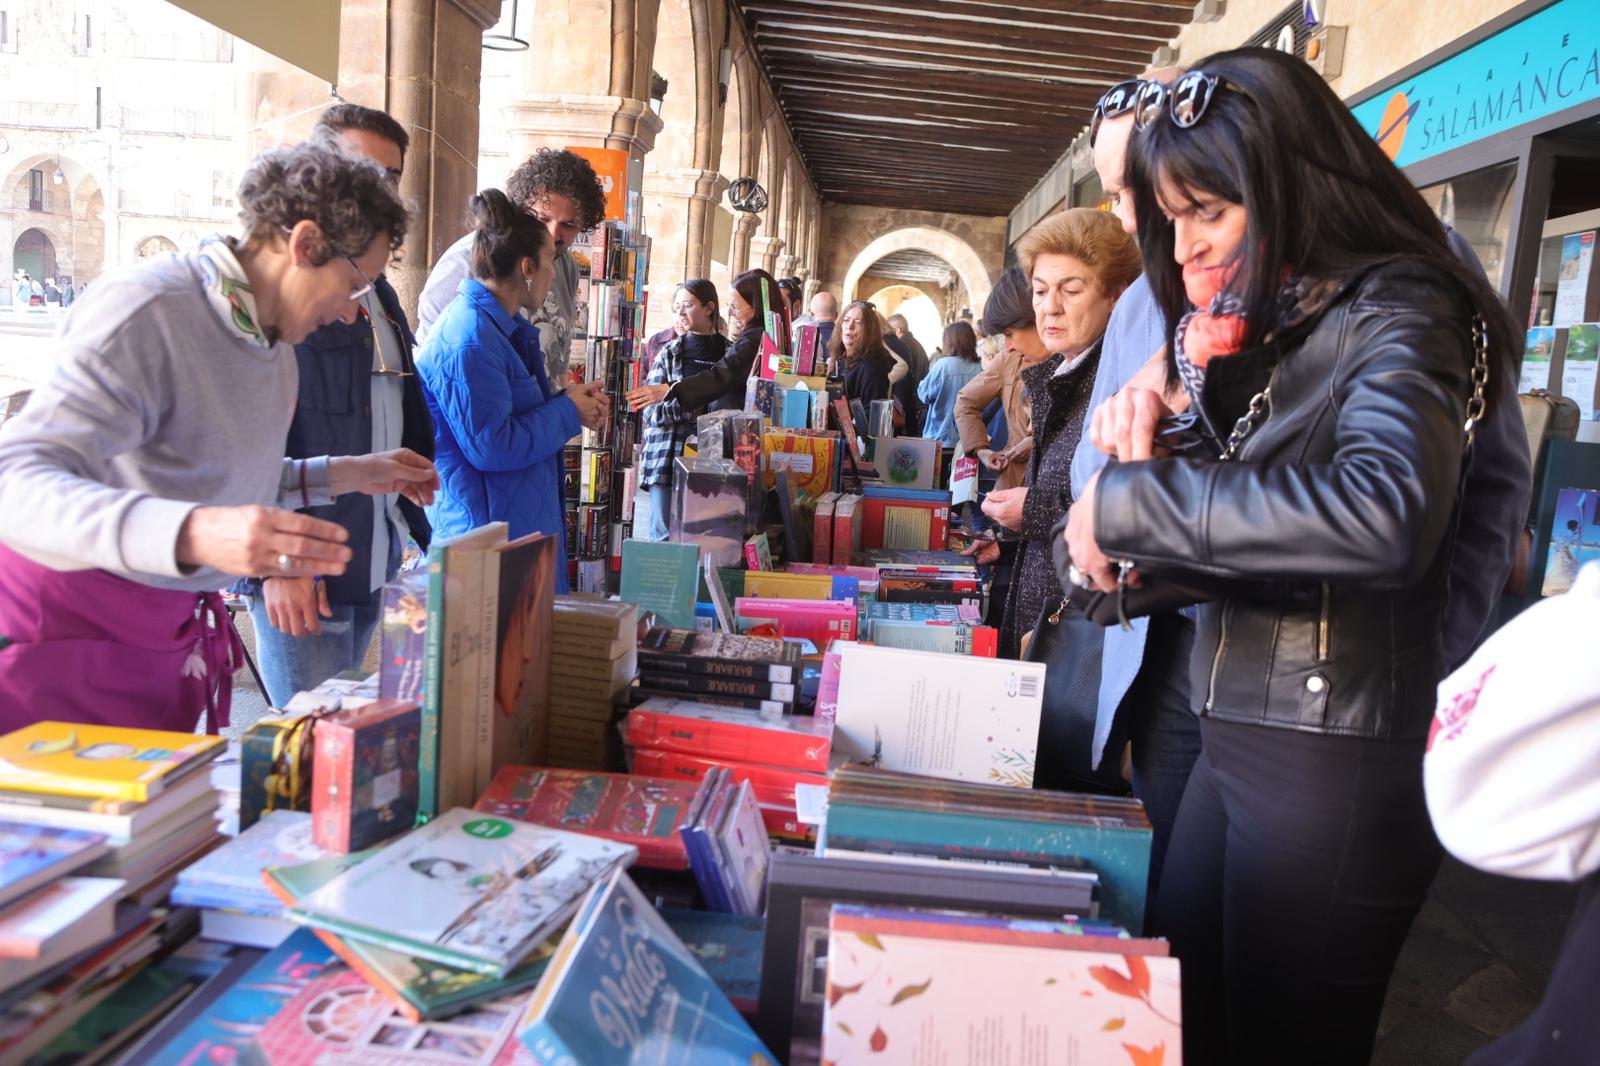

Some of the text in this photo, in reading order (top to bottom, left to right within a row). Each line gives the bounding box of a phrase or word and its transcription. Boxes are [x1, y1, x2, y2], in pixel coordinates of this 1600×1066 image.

[1420, 48, 1600, 150] SALAMANCA
[705, 662, 753, 678] BARBARIE
[708, 680, 755, 696] BARBARIE
